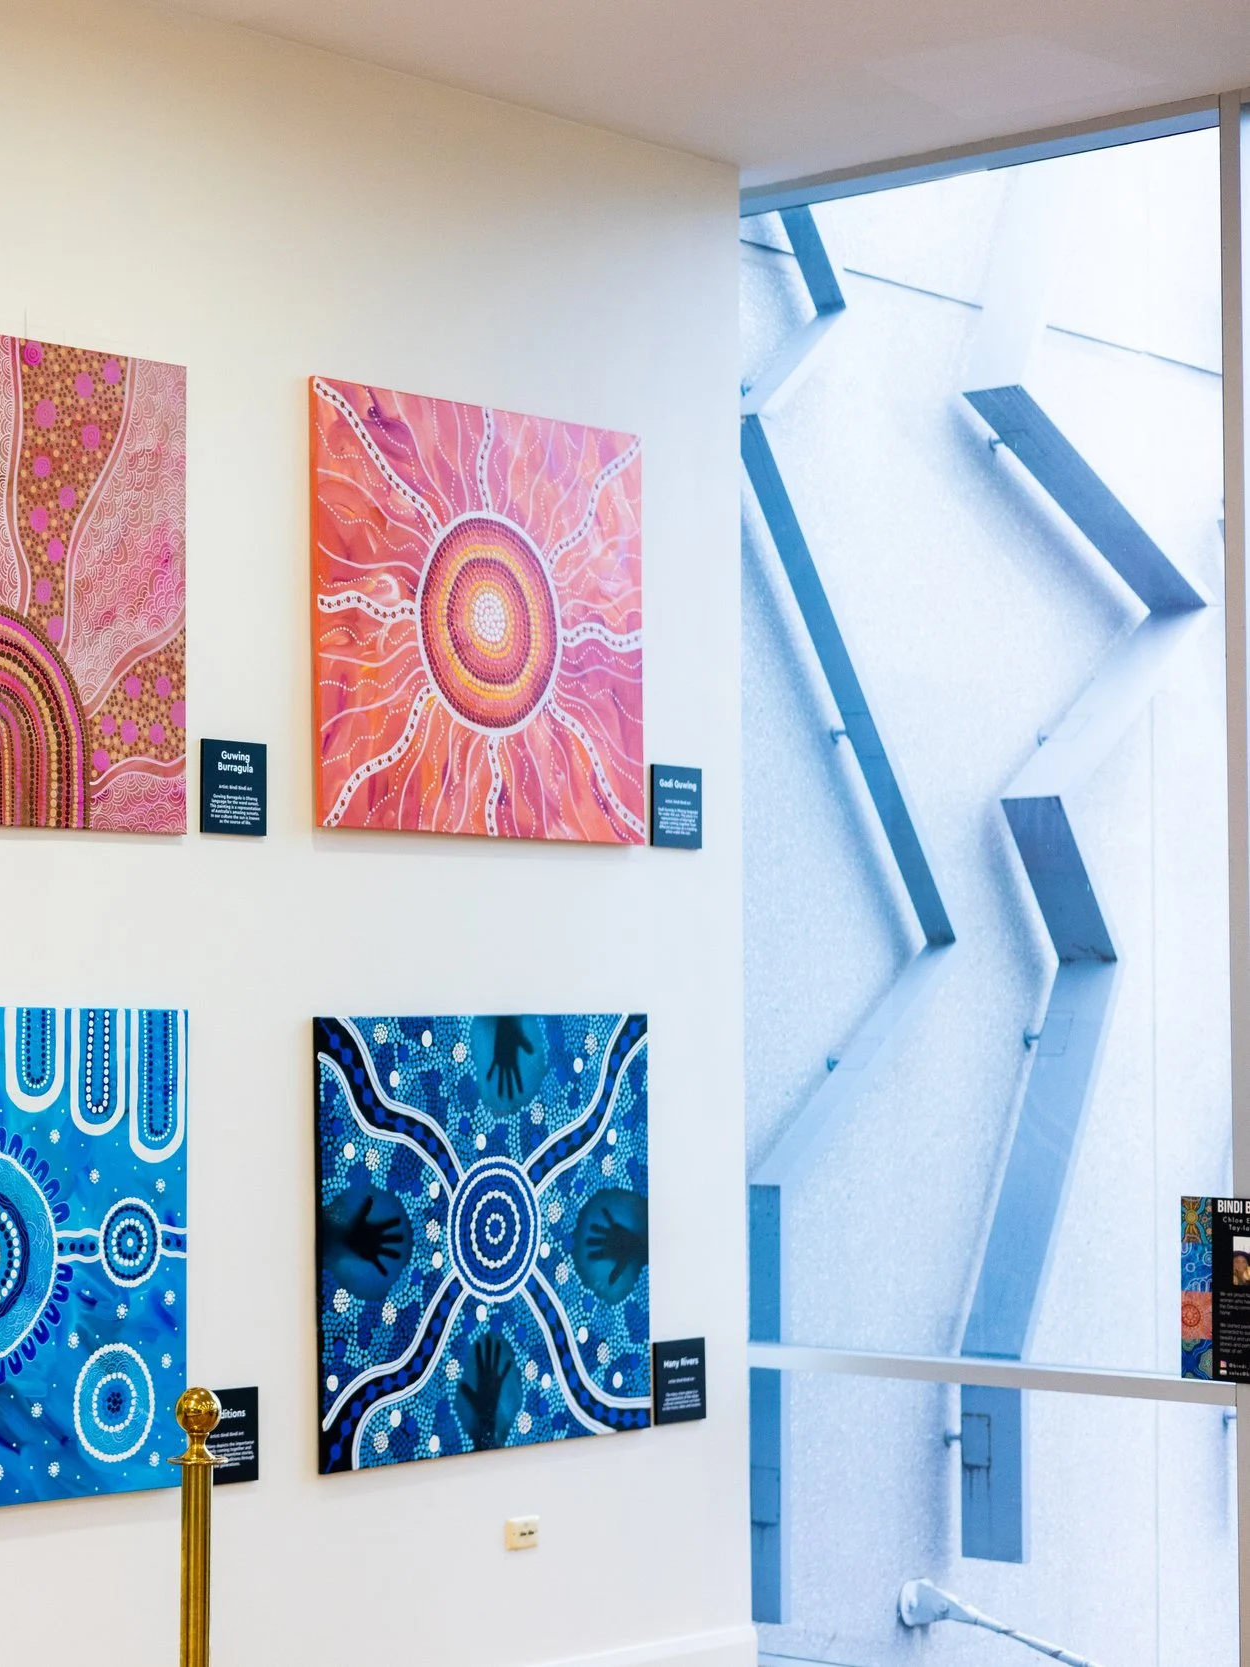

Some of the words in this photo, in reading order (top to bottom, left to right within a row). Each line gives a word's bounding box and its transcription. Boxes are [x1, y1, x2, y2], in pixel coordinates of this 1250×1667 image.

[221, 750, 250, 763] Guwing
[218, 762, 253, 774] Burragula
[659, 779, 673, 788] Gadi
[674, 780, 697, 792] Guwing
[1218, 1200, 1243, 1214] BINDI
[663, 1360, 680, 1370] Many
[680, 1356, 699, 1366] Rivers
